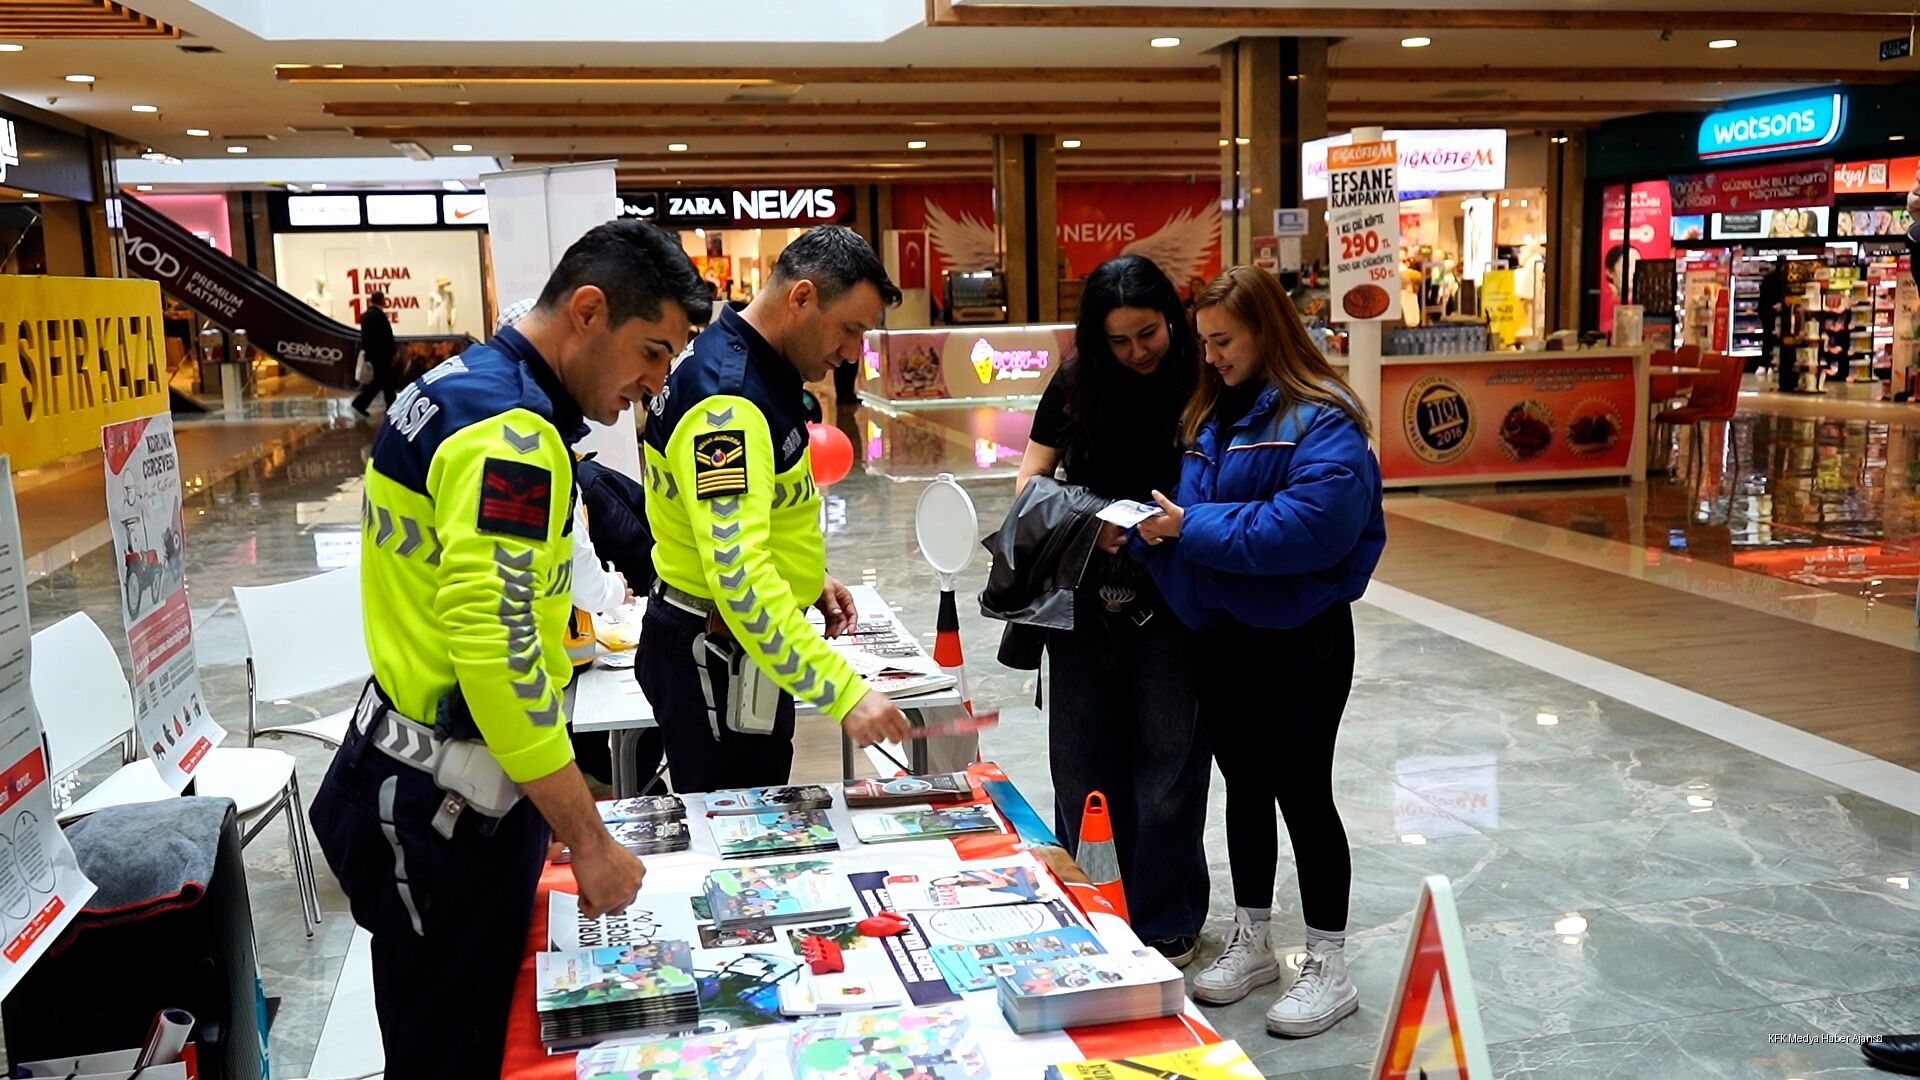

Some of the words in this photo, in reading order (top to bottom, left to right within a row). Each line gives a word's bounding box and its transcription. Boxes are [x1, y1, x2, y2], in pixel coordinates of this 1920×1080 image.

[1713, 109, 1816, 145] watsons
[1331, 168, 1393, 193] EFSANE
[669, 198, 726, 215] ZARA
[1332, 190, 1396, 208] KAMPANYA
[1341, 230, 1379, 260] 290
[347, 268, 360, 295] 1
[364, 266, 411, 280] ALANA
[1369, 267, 1387, 280] 150
[184, 281, 237, 319] KATTAYIZ
[191, 270, 244, 309] PREMIUM
[364, 282, 391, 295] BUY
[349, 298, 361, 325] 1
[18, 318, 94, 424] SIFIR
[95, 315, 161, 404] KAZA
[1436, 426, 1463, 446] 2016
